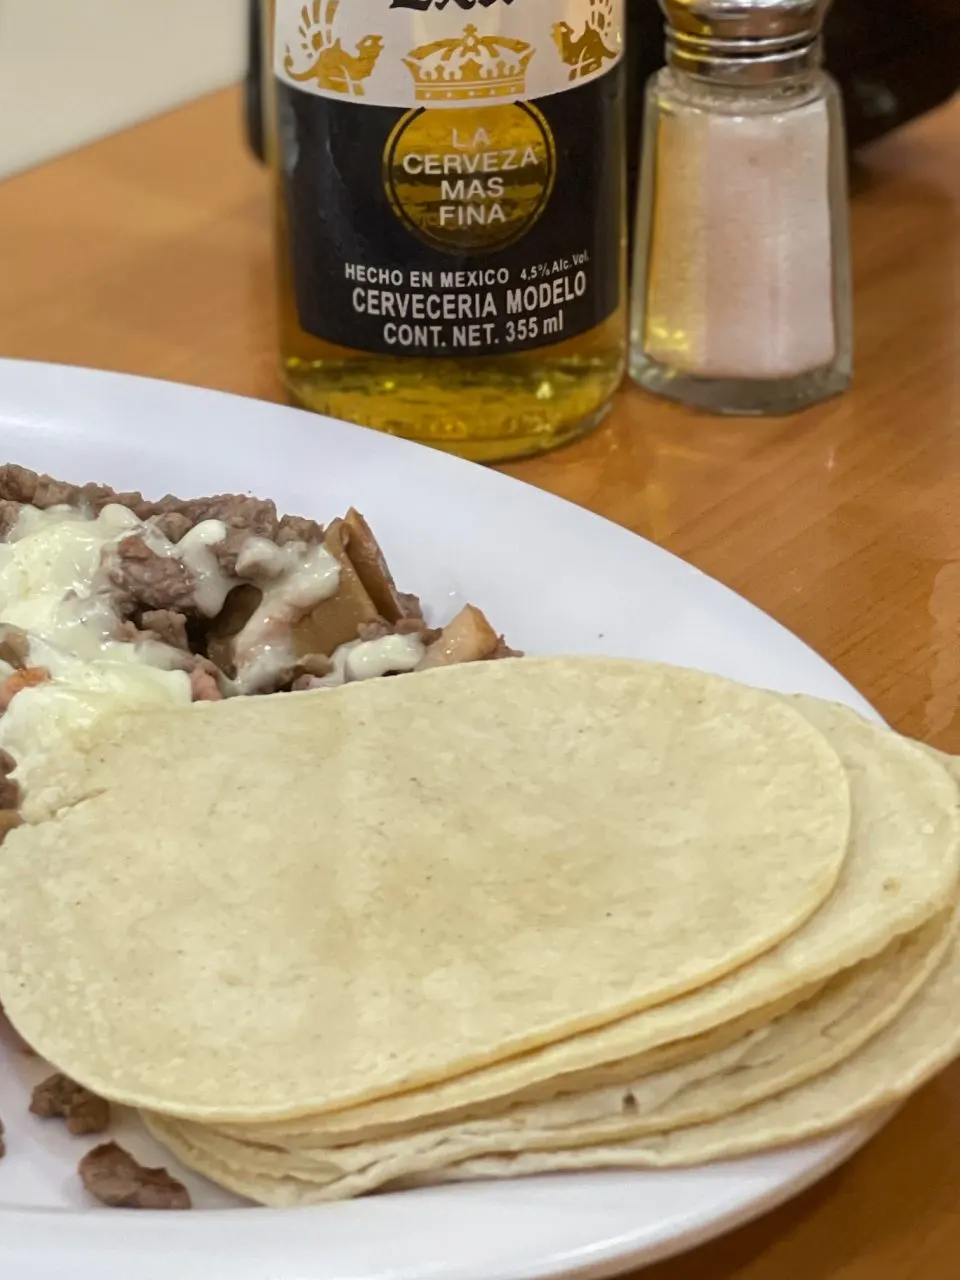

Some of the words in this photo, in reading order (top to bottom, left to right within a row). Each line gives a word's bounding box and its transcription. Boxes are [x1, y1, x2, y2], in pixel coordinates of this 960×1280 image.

[452, 127, 490, 148] LA
[402, 146, 539, 175] CERVEZA
[440, 177, 504, 201] MAS
[439, 204, 506, 226] FINA
[345, 263, 404, 286] HECHO
[410, 271, 432, 287] EN
[440, 268, 510, 287] MEXICO
[520, 262, 551, 280] 4.5%
[352, 287, 498, 319] CERVECERIA
[506, 271, 587, 315] MODELO
[383, 323, 447, 347] CONT.
[453, 323, 499, 346] NET.
[505, 317, 538, 342] 355
[542, 309, 564, 334] ml
